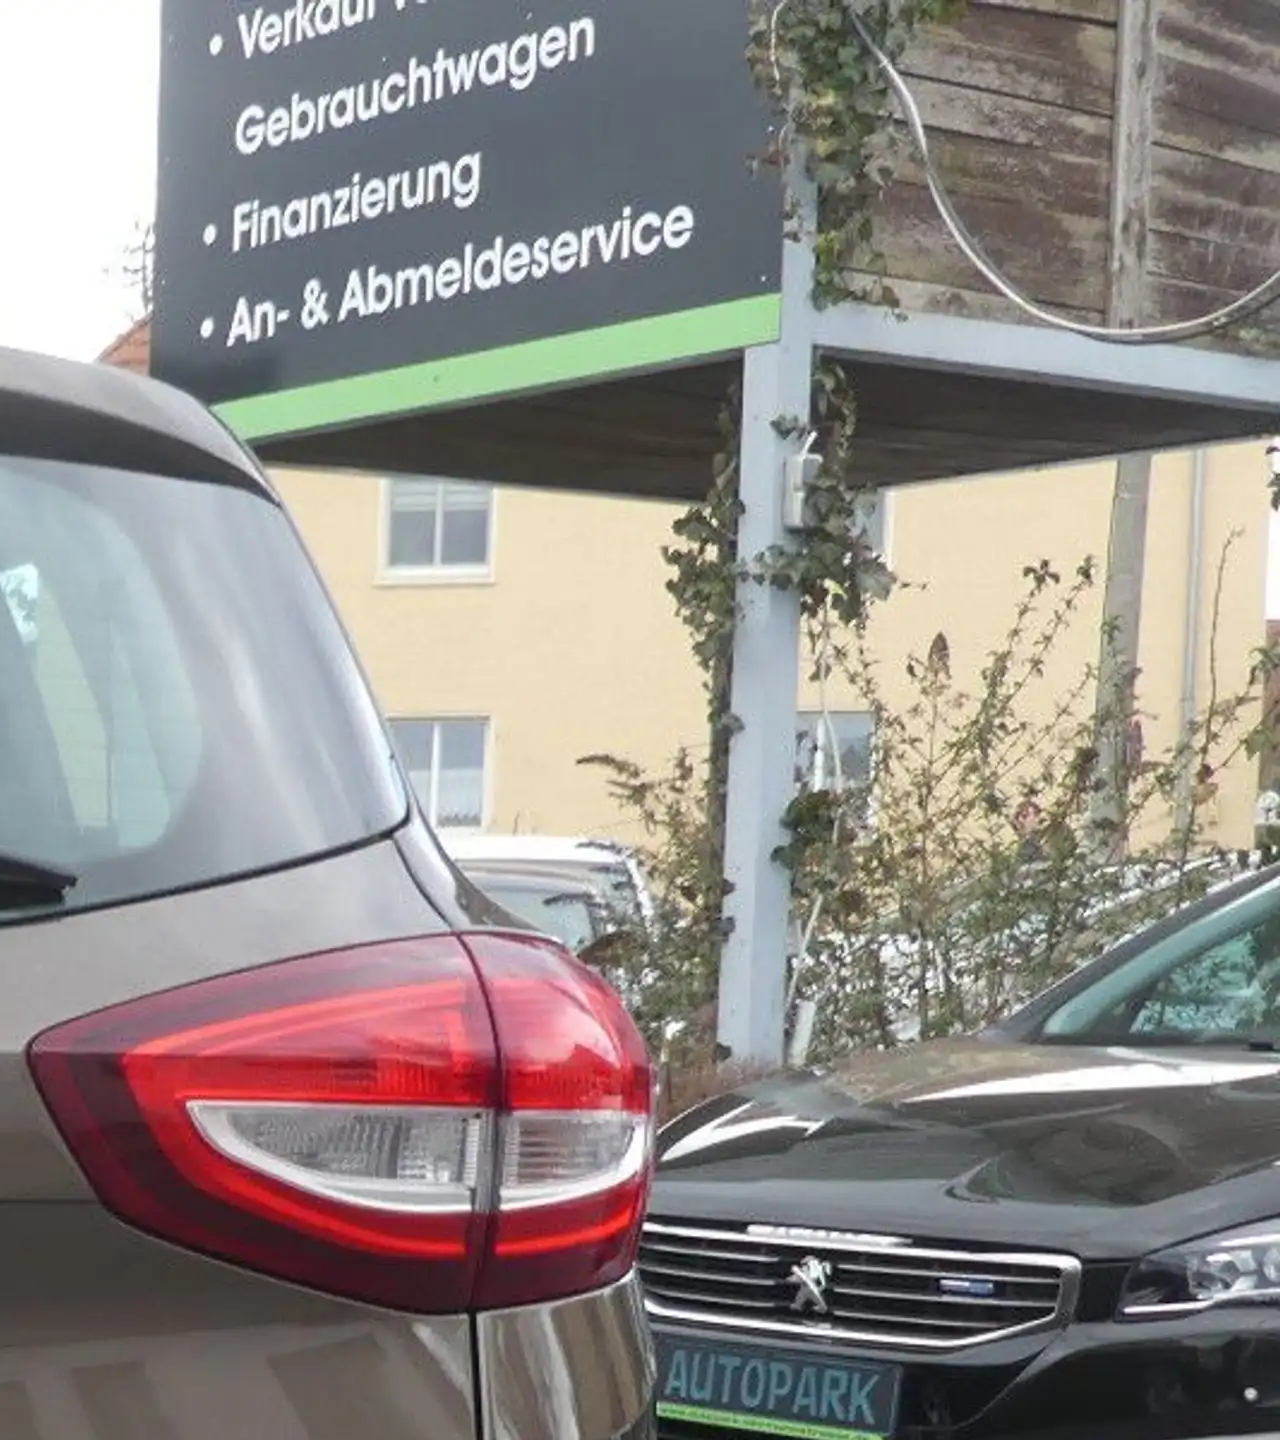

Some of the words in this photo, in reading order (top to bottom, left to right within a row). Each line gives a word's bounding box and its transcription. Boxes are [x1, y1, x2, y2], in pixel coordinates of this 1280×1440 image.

[234, 17, 595, 155] Gebrauchtwagen
[232, 152, 481, 253] Finanzierung
[226, 296, 290, 347] An-
[300, 278, 330, 330] &
[337, 205, 694, 322] Abmeldeservice
[662, 1349, 880, 1426] AUTOPARK
